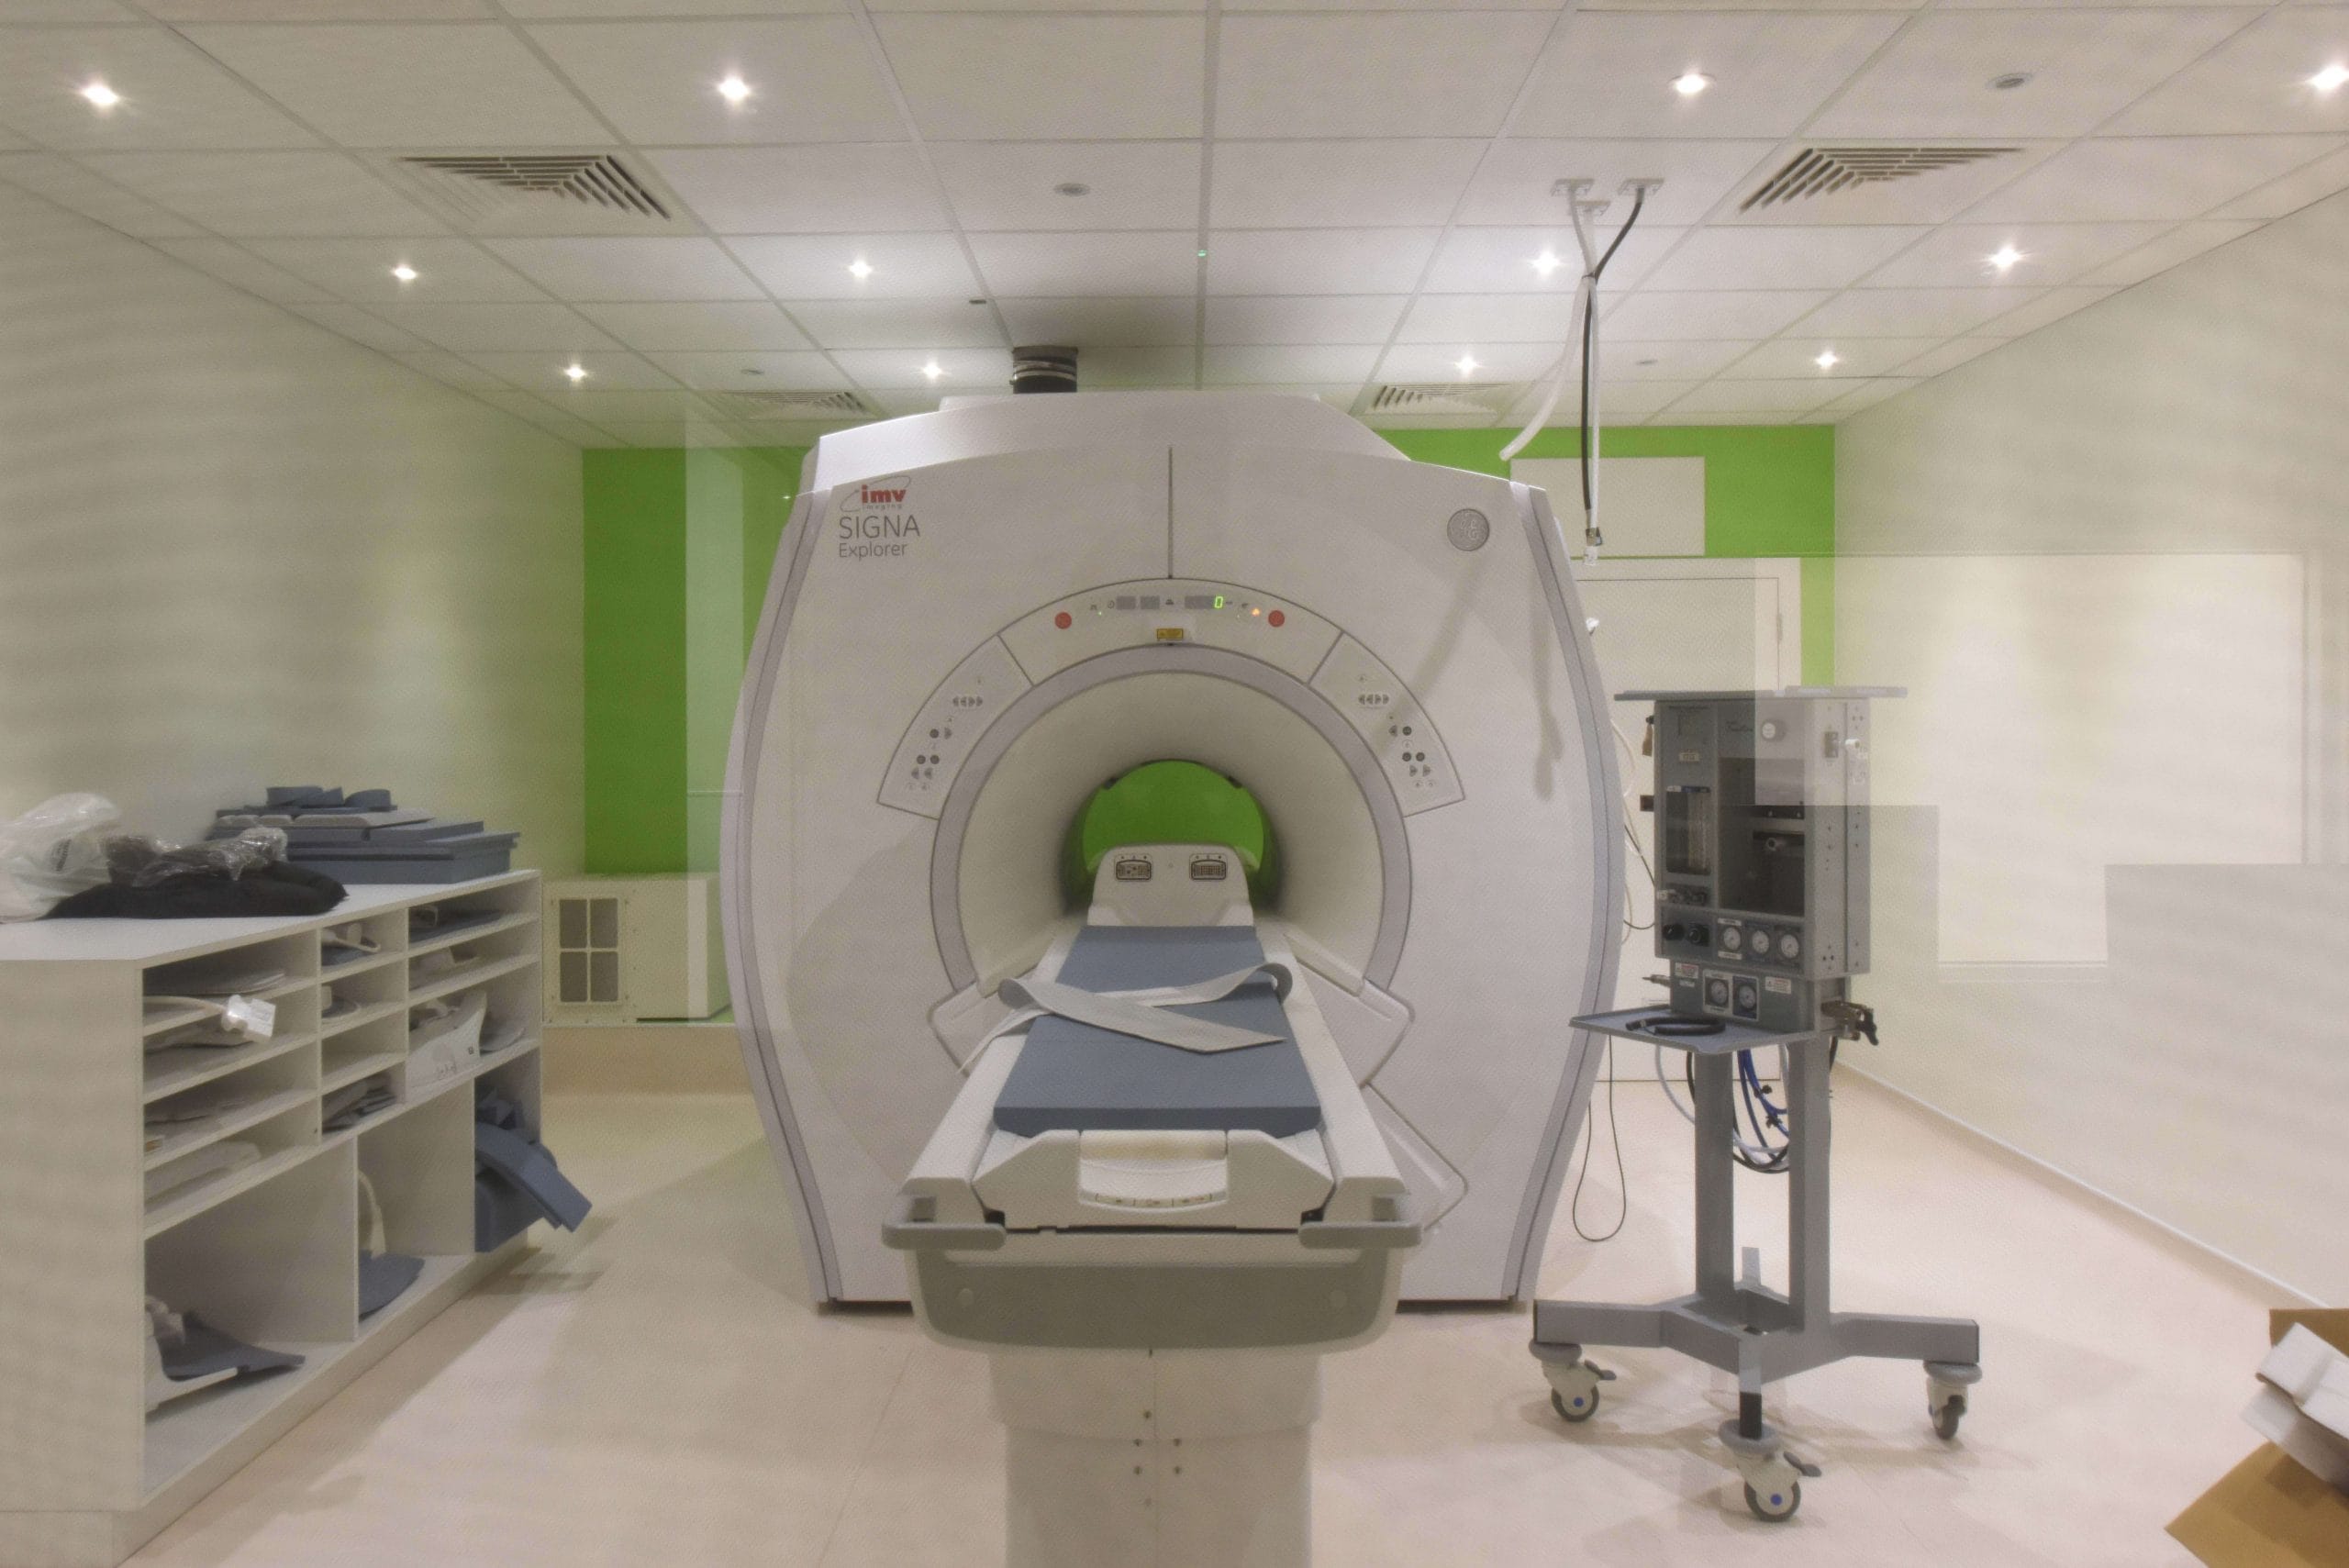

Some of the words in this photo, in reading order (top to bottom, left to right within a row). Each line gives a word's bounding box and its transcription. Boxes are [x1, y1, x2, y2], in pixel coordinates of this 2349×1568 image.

[861, 484, 907, 504] imv
[839, 515, 920, 539] SIGNA
[839, 541, 907, 562] Explorer
[1214, 595, 1224, 609] 0
